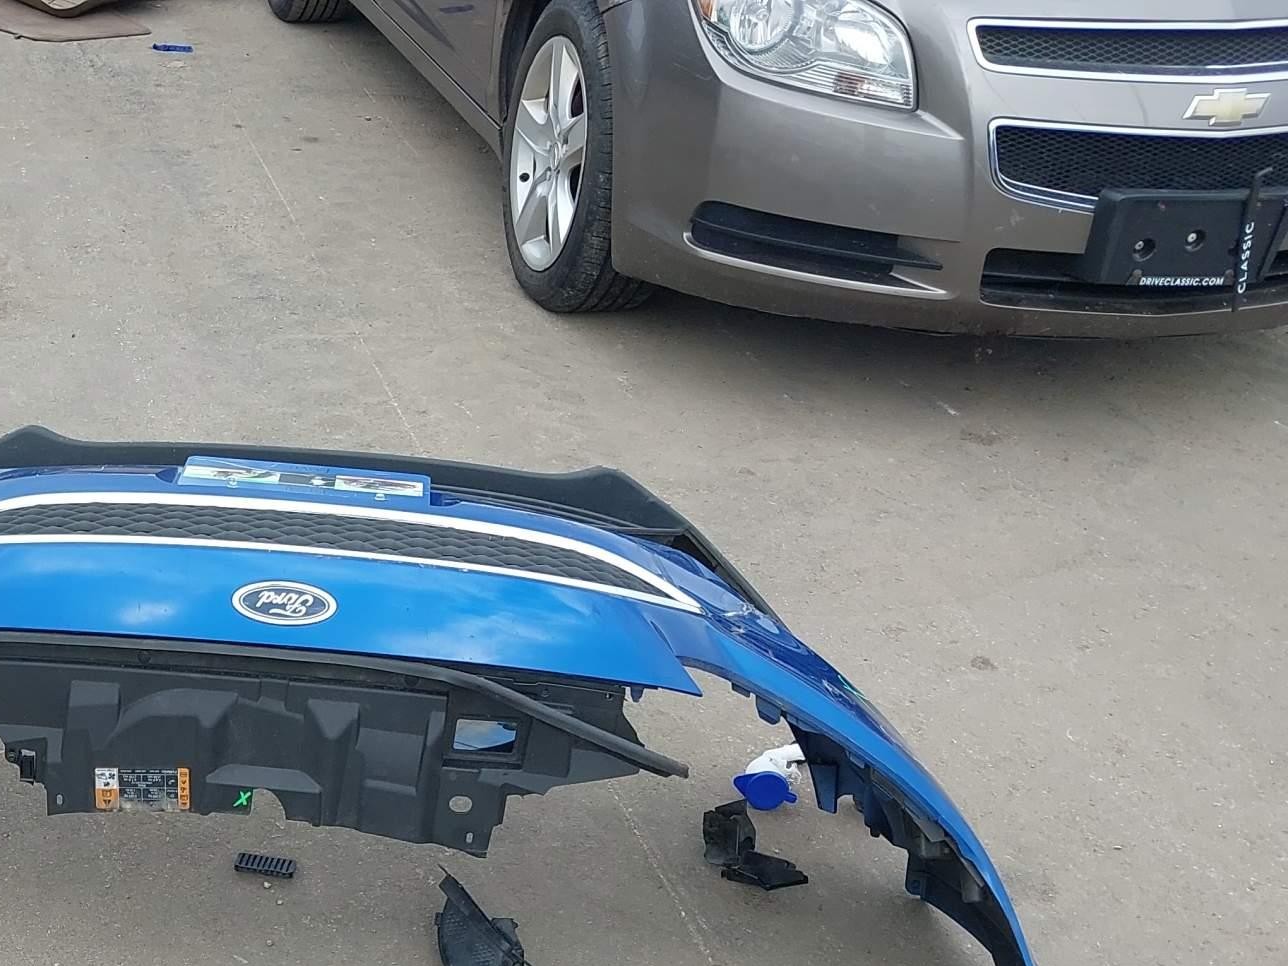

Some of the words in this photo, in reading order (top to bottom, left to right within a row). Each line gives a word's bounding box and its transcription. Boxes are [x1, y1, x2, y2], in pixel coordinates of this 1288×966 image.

[1237, 221, 1255, 294] CLASSIC
[1139, 276, 1225, 287] DRIVECLASSIC.COM
[255, 590, 314, 617] Ford
